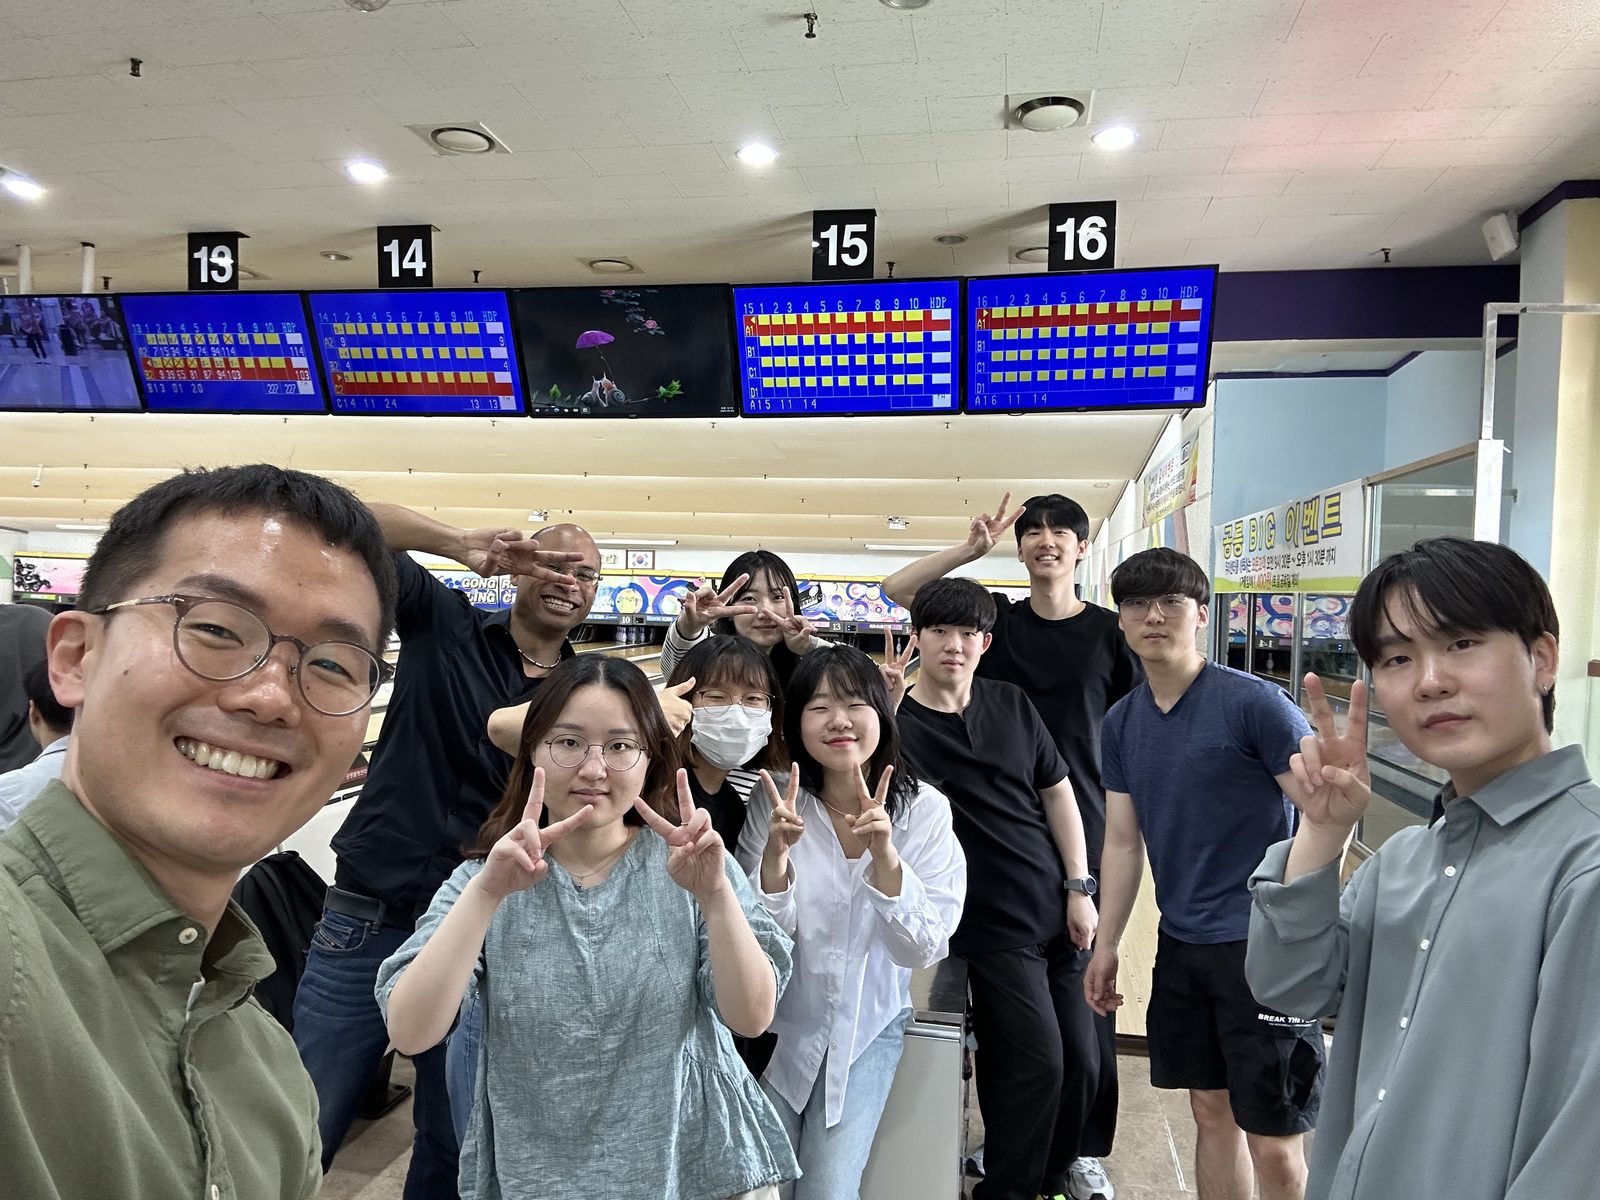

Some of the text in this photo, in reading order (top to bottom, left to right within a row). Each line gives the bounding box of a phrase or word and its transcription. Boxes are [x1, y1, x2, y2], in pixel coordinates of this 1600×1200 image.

[1056, 215, 1108, 261] 16
[820, 224, 868, 266] 15
[384, 239, 426, 277] 14
[193, 245, 234, 283] 13
[978, 286, 1198, 307] 16 1 2 3 4 5 6 7 8 9 10 HDP
[744, 297, 946, 314] 15 1 2 3 4 5 6 7 8 9 10 HDP
[319, 311, 497, 322] 14 1 2 3 4 5 6 7 8 9 10 HDP
[977, 319, 985, 330] A1
[746, 326, 753, 335] A1
[341, 337, 346, 347] 9
[499, 336, 504, 346] 9
[977, 341, 985, 352] B1
[747, 347, 755, 357] B1
[346, 361, 351, 370] 4
[504, 361, 509, 371] 4
[977, 362, 984, 373] C1
[749, 368, 756, 377] C1
[750, 388, 758, 397] D1
[977, 383, 984, 393] D1
[337, 398, 498, 409] C14 11 24 13 13
[750, 399, 816, 410] A15 11 14
[975, 393, 1047, 406] A16 11 14
[1249, 512, 1276, 552] BIG
[1285, 492, 1342, 548] 이벤트
[1296, 551, 1306, 567] 오후
[1314, 548, 1325, 566] 30분
[1326, 546, 1336, 565] 까지
[462, 578, 496, 589] GONG
[1258, 1013, 1286, 1022] BREAK
